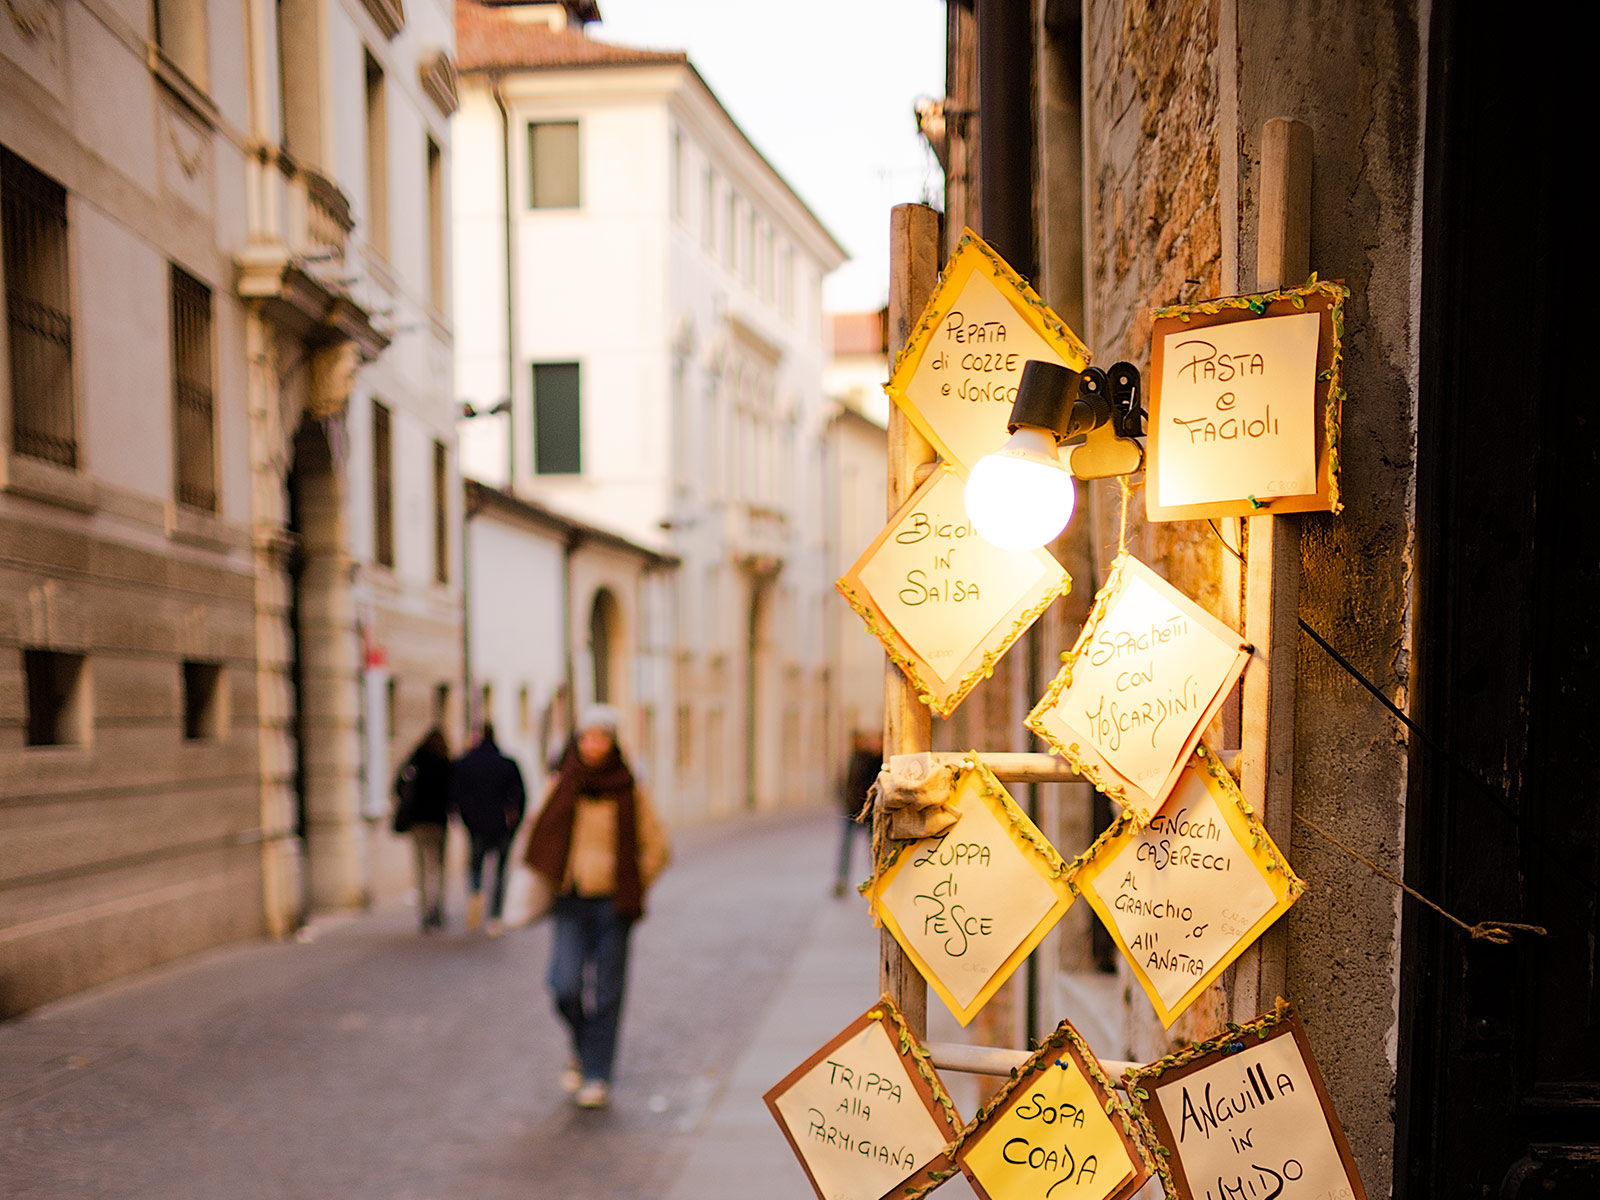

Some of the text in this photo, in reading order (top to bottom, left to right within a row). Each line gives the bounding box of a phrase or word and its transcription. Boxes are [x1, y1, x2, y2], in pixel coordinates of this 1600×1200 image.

[931, 351, 1020, 373] di COZZE
[1174, 340, 1264, 384] PASTA
[1116, 660, 1154, 692] CON
[933, 872, 958, 897] di
[913, 894, 994, 958] PESCE
[1146, 949, 1204, 976] ANATRA
[826, 1060, 902, 1104] TRIPPA
[1015, 1093, 1085, 1129] SOPA
[807, 1107, 915, 1171] PARMIGIANA
[1002, 1137, 1098, 1199] COADA
